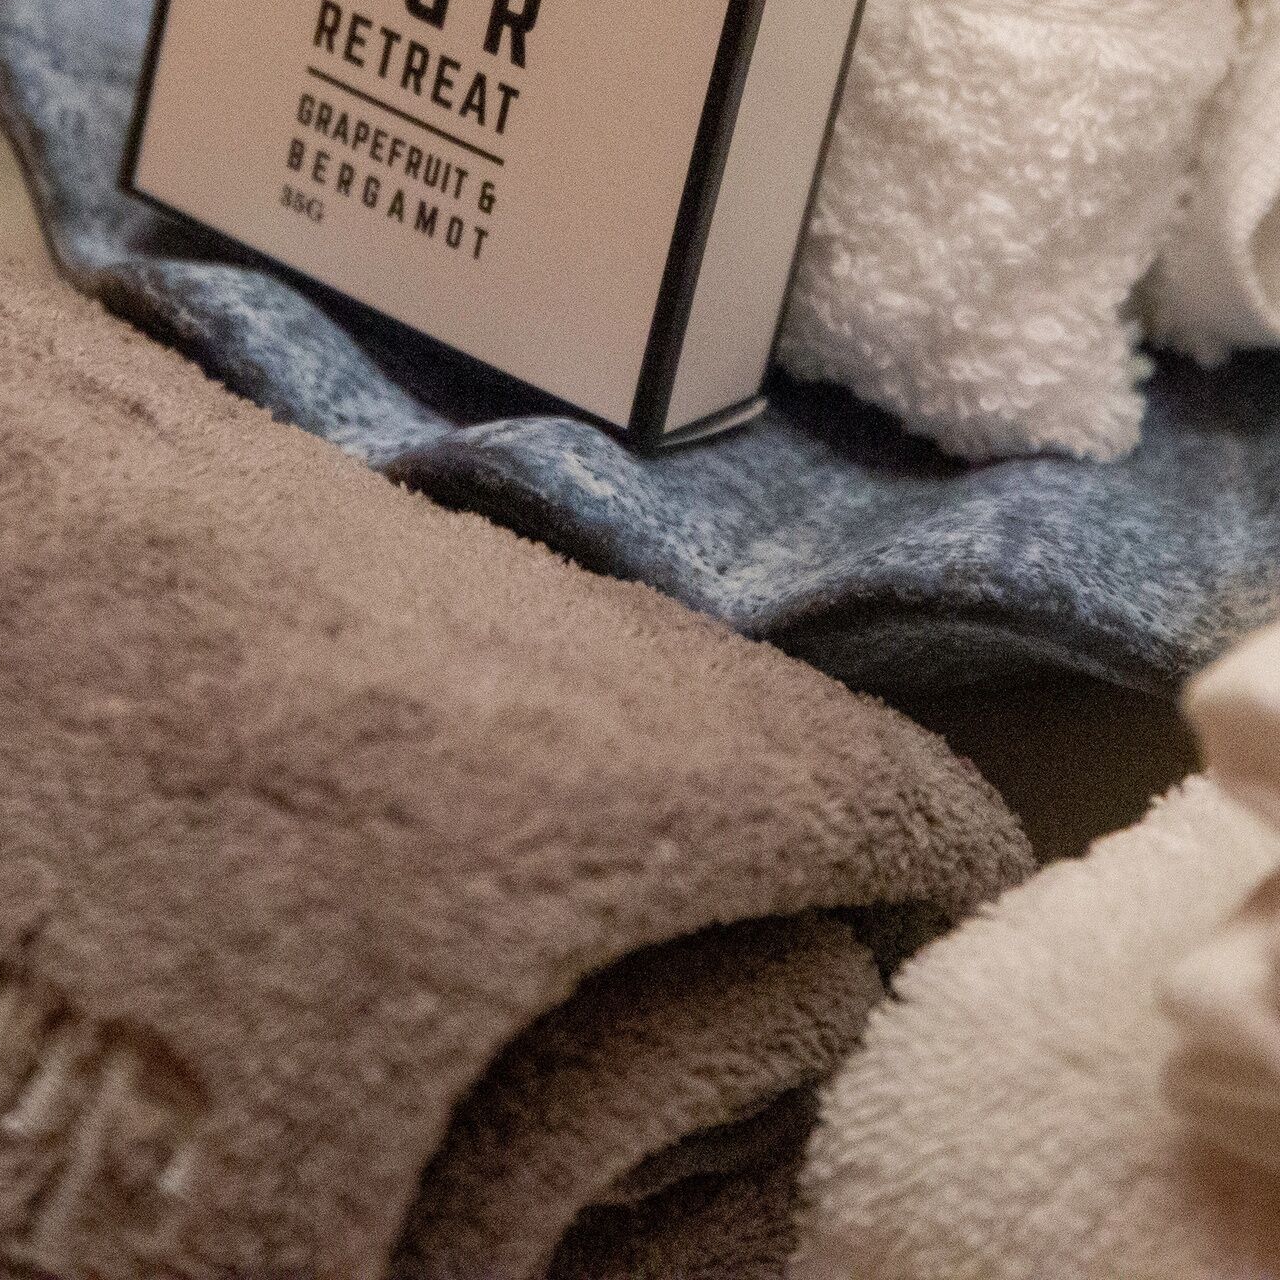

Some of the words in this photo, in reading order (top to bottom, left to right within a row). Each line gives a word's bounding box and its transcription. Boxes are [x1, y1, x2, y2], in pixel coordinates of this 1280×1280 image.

[286, 137, 489, 260] BERGAMOT
[296, 93, 469, 200] GRAPEFRUIT
[477, 179, 497, 216] &
